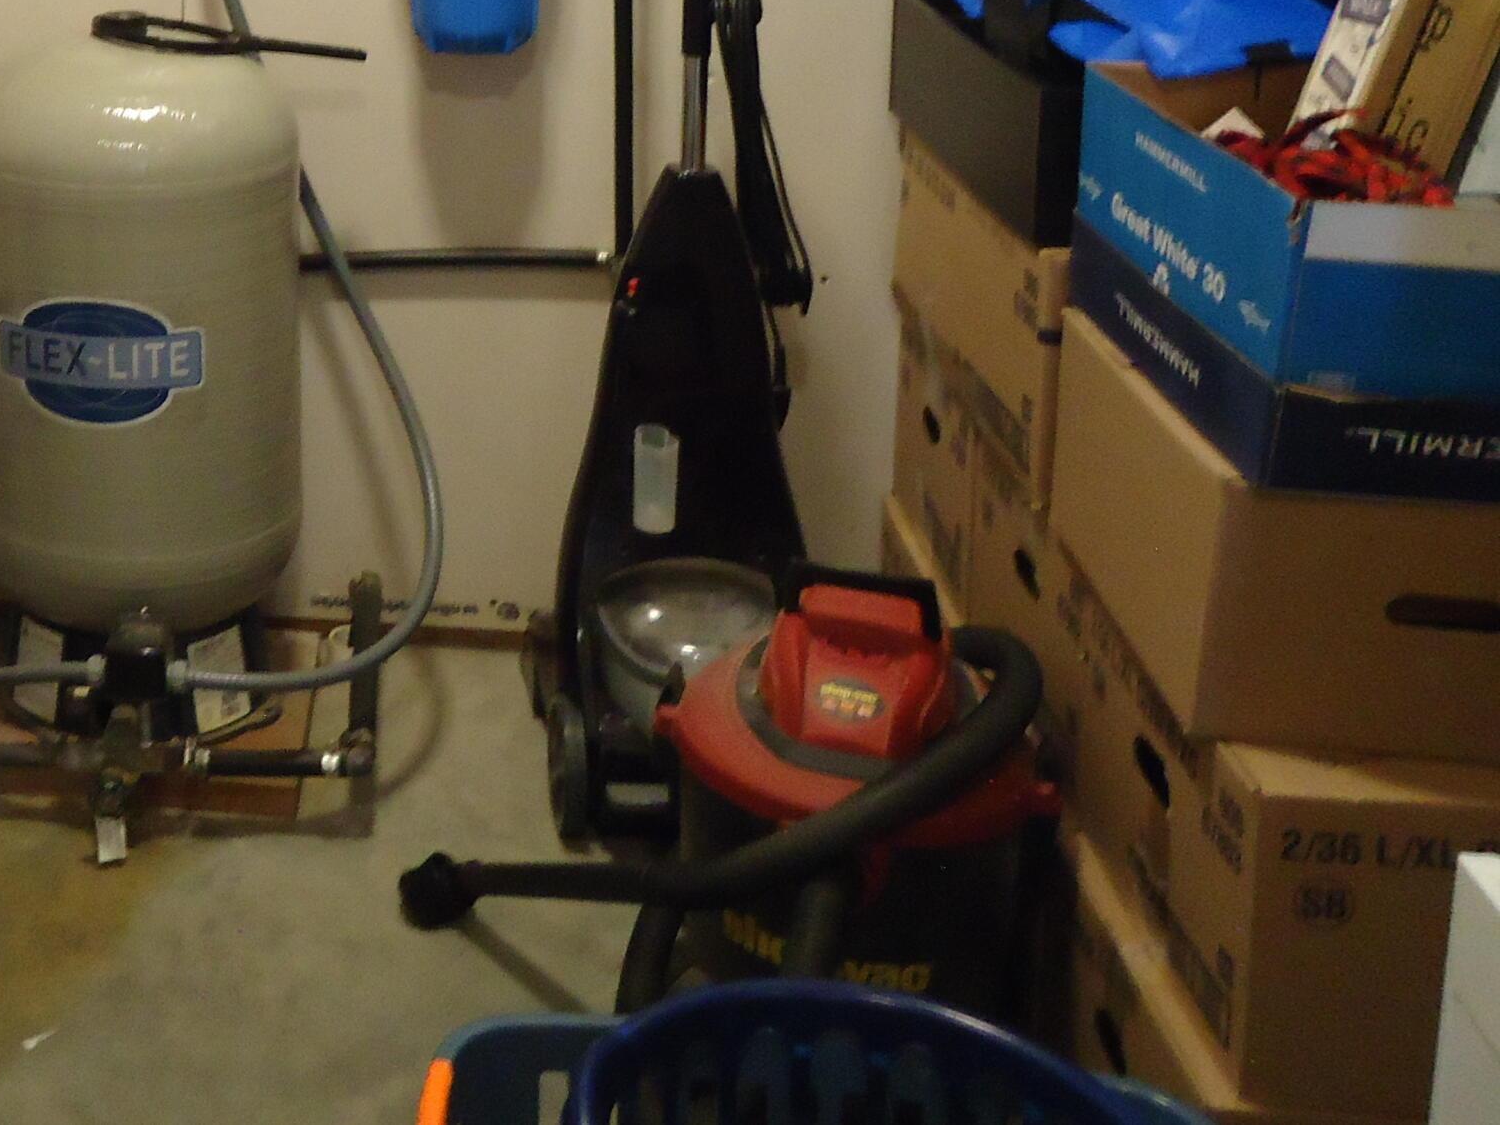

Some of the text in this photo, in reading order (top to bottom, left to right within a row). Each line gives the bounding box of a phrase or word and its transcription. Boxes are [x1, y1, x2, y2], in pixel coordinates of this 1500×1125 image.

[1111, 191, 1151, 244] Great
[1152, 223, 1200, 281] White
[8, 328, 191, 381] FLEX-LITE
